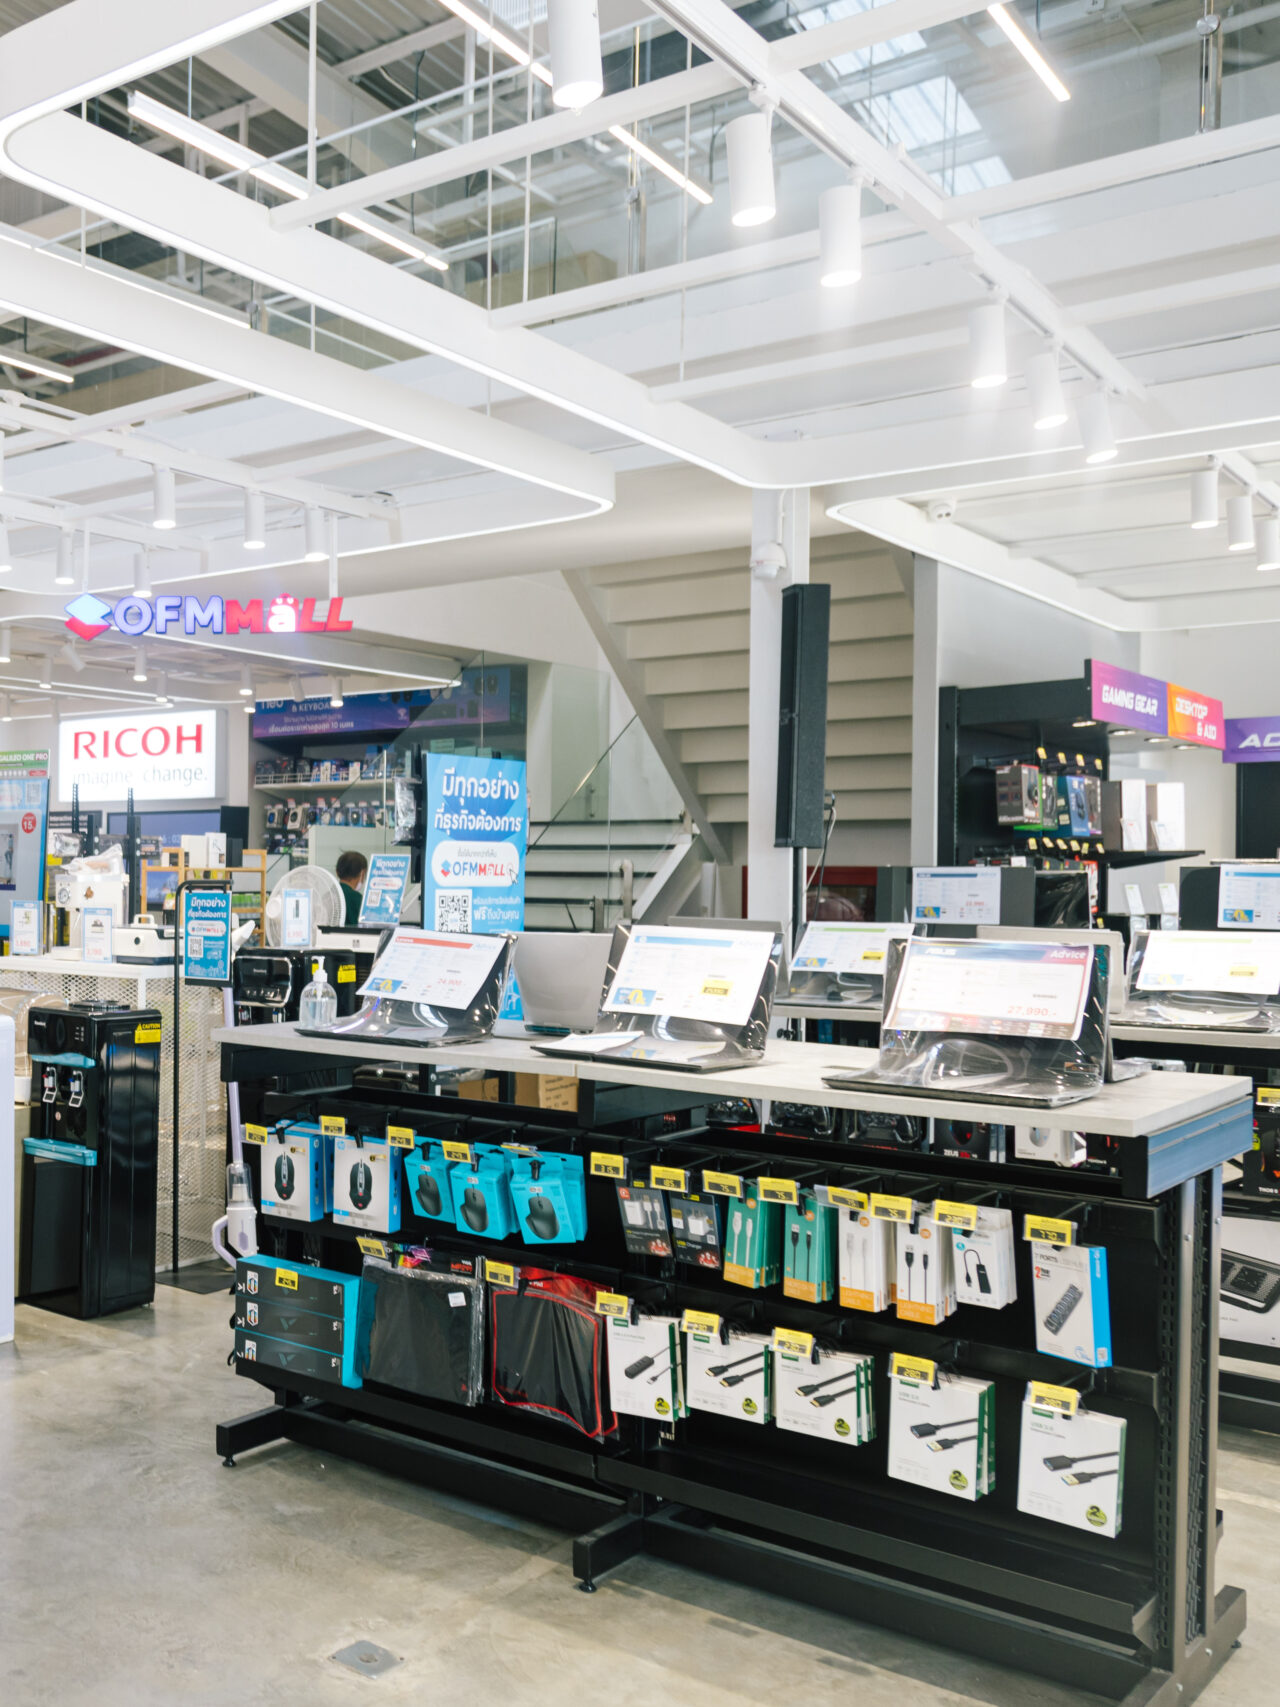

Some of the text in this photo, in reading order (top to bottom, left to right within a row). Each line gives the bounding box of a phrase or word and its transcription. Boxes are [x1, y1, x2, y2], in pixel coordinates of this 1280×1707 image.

[1102, 685, 1158, 717] GAMING GEAR
[1175, 697, 1208, 720] DESKTOP
[73, 724, 203, 760] RICOH
[143, 765, 208, 787] change.
[442, 767, 519, 806] มีทุกอย่าง
[1050, 950, 1086, 960] Advice
